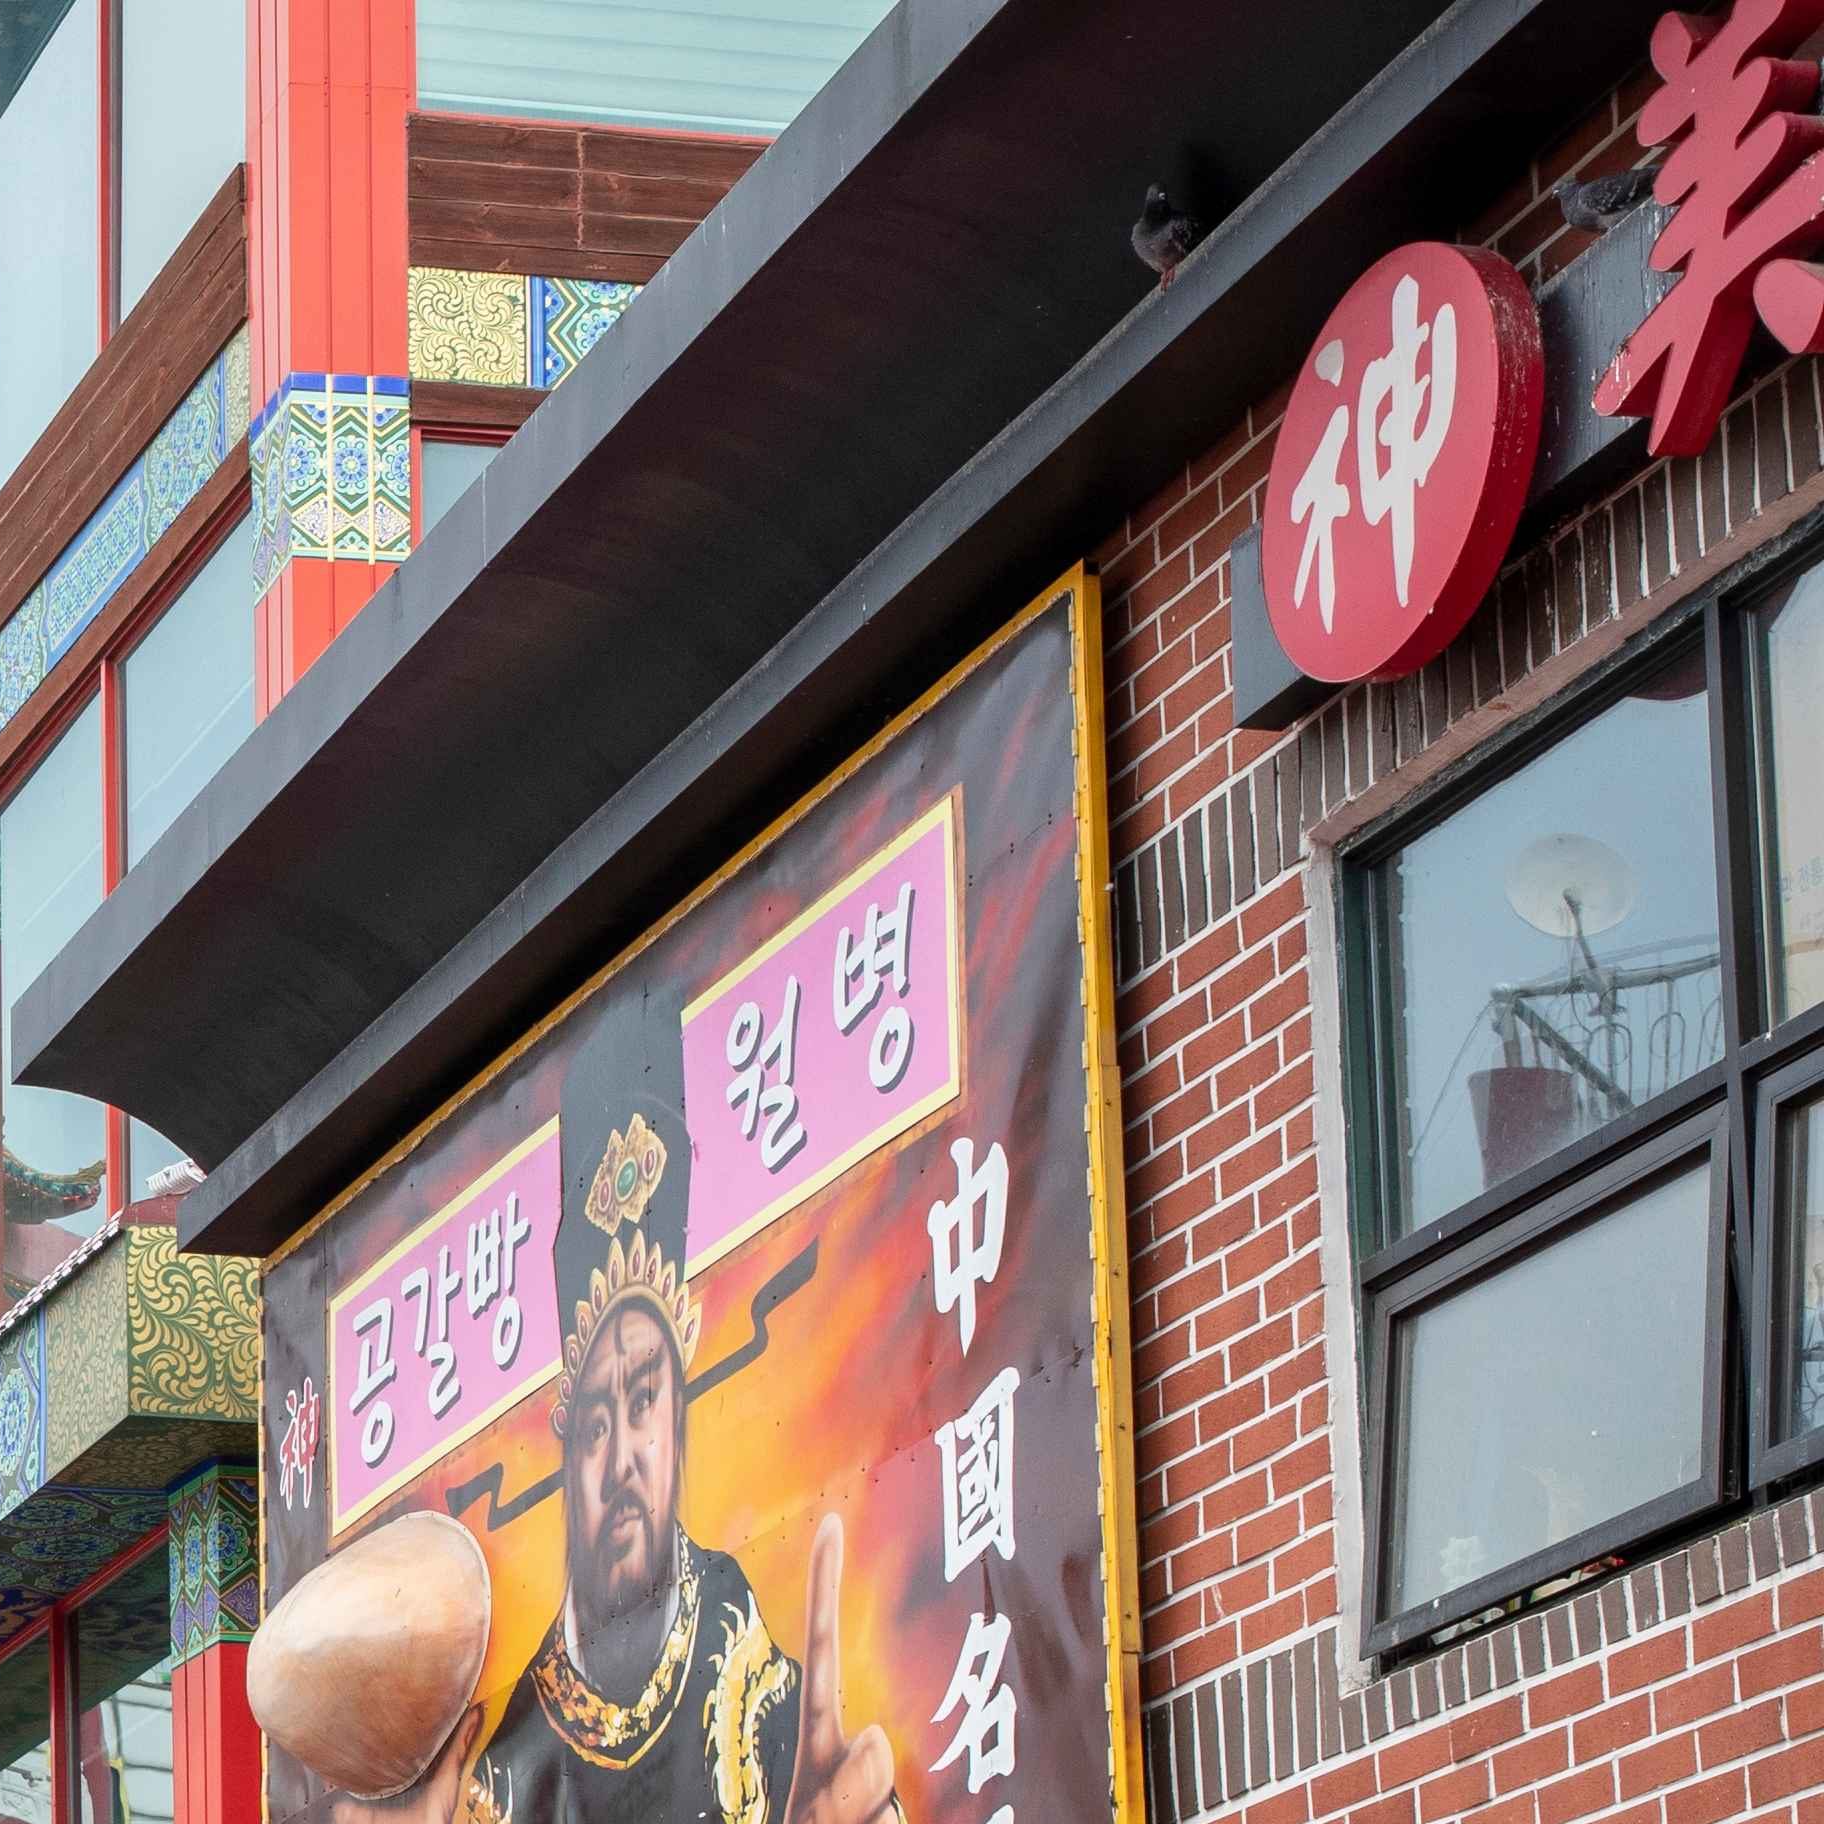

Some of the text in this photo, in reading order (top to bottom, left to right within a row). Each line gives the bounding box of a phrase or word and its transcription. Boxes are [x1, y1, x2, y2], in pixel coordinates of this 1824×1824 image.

[1291, 274, 1456, 634] 神
[724, 880, 917, 1176] 월병
[347, 1190, 532, 1471] 공갈빵
